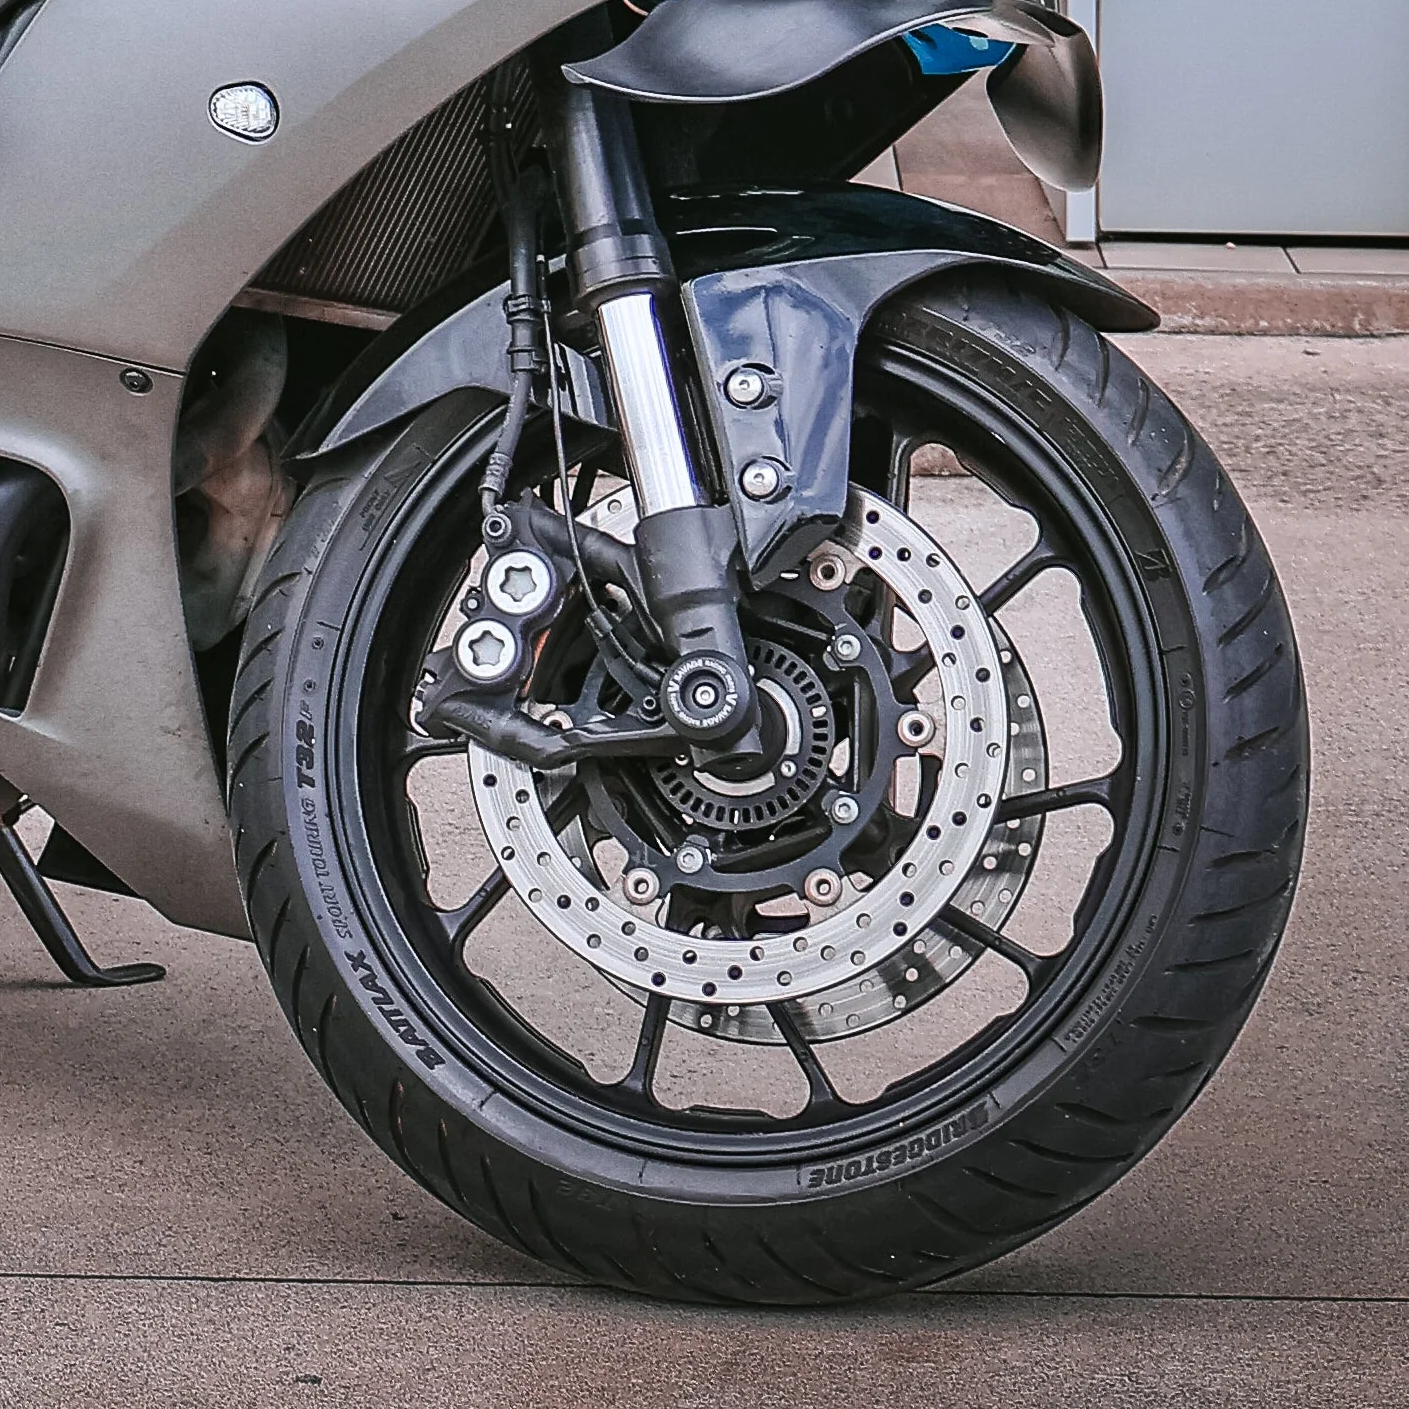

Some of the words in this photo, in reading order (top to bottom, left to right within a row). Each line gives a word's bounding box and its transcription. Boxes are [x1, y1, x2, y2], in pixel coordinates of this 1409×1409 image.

[300, 797, 330, 881] TOURING
[319, 881, 353, 940] SPORT
[344, 948, 447, 1072] BATTLAX
[807, 1099, 990, 1190] BRIDGESTONE
